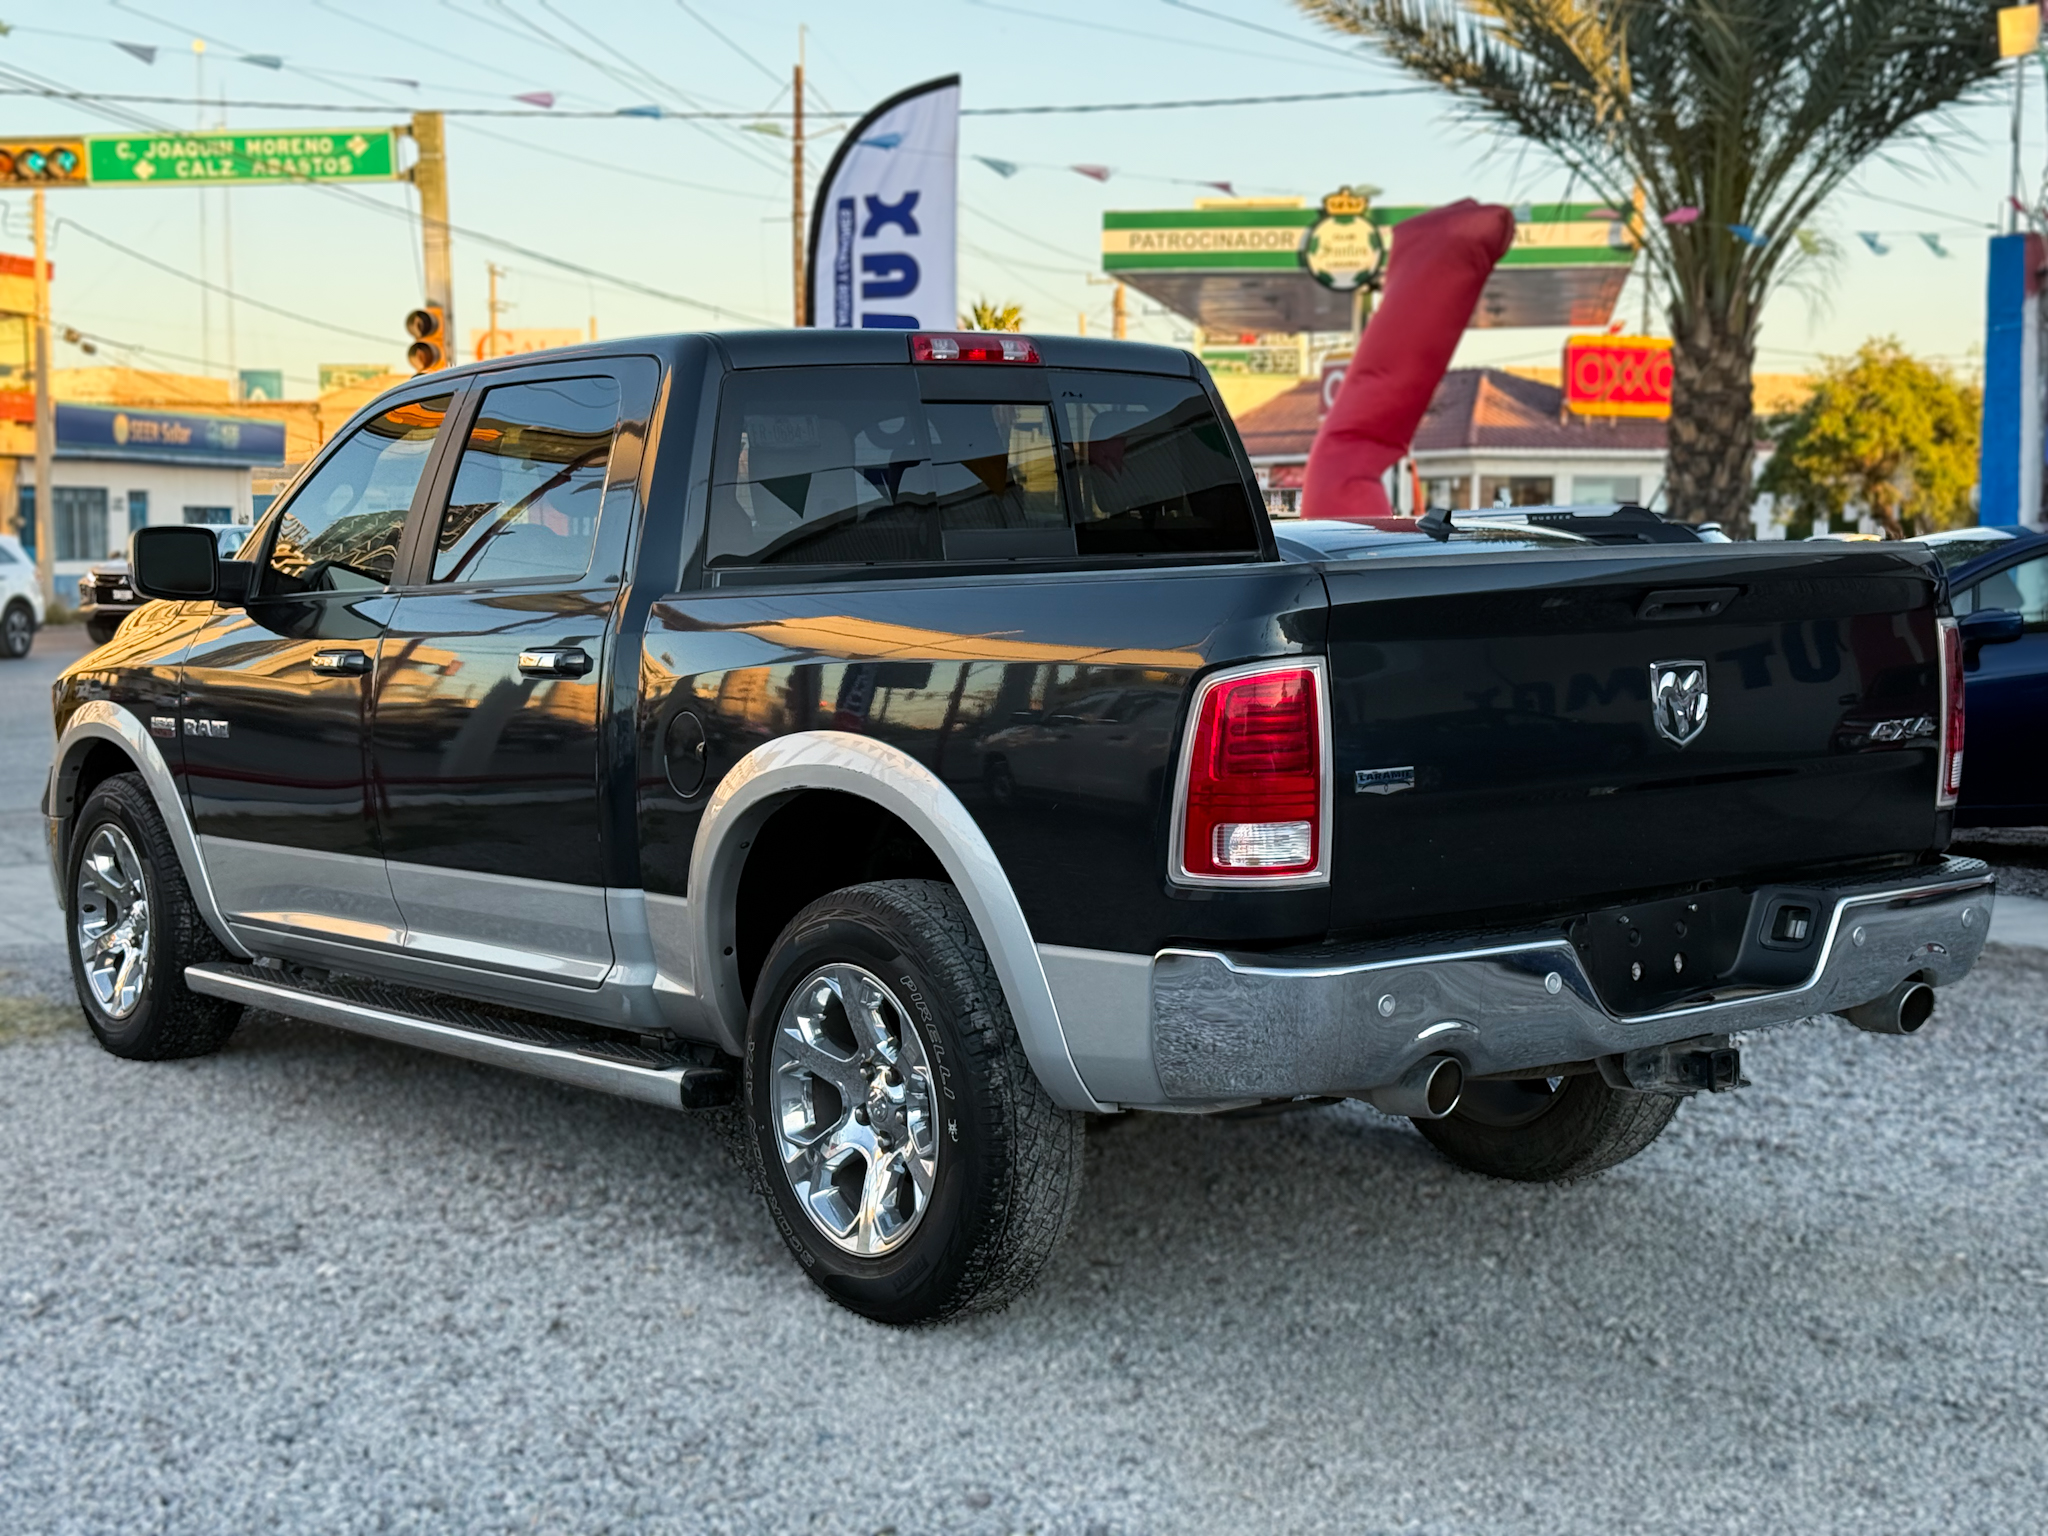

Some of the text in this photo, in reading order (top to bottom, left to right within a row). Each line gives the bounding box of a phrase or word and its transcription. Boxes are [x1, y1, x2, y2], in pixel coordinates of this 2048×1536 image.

[115, 137, 335, 160] C. JOAQUIN MORENO
[252, 155, 353, 177] ABASTOS
[1128, 230, 1295, 250] PATROCINADOR
[1575, 351, 1673, 397] OXXO
[183, 717, 230, 739] RAM
[1357, 769, 1414, 782] LARAMIE
[901, 975, 956, 1101] PIRELLI
[747, 1115, 816, 1268] SCORPION
